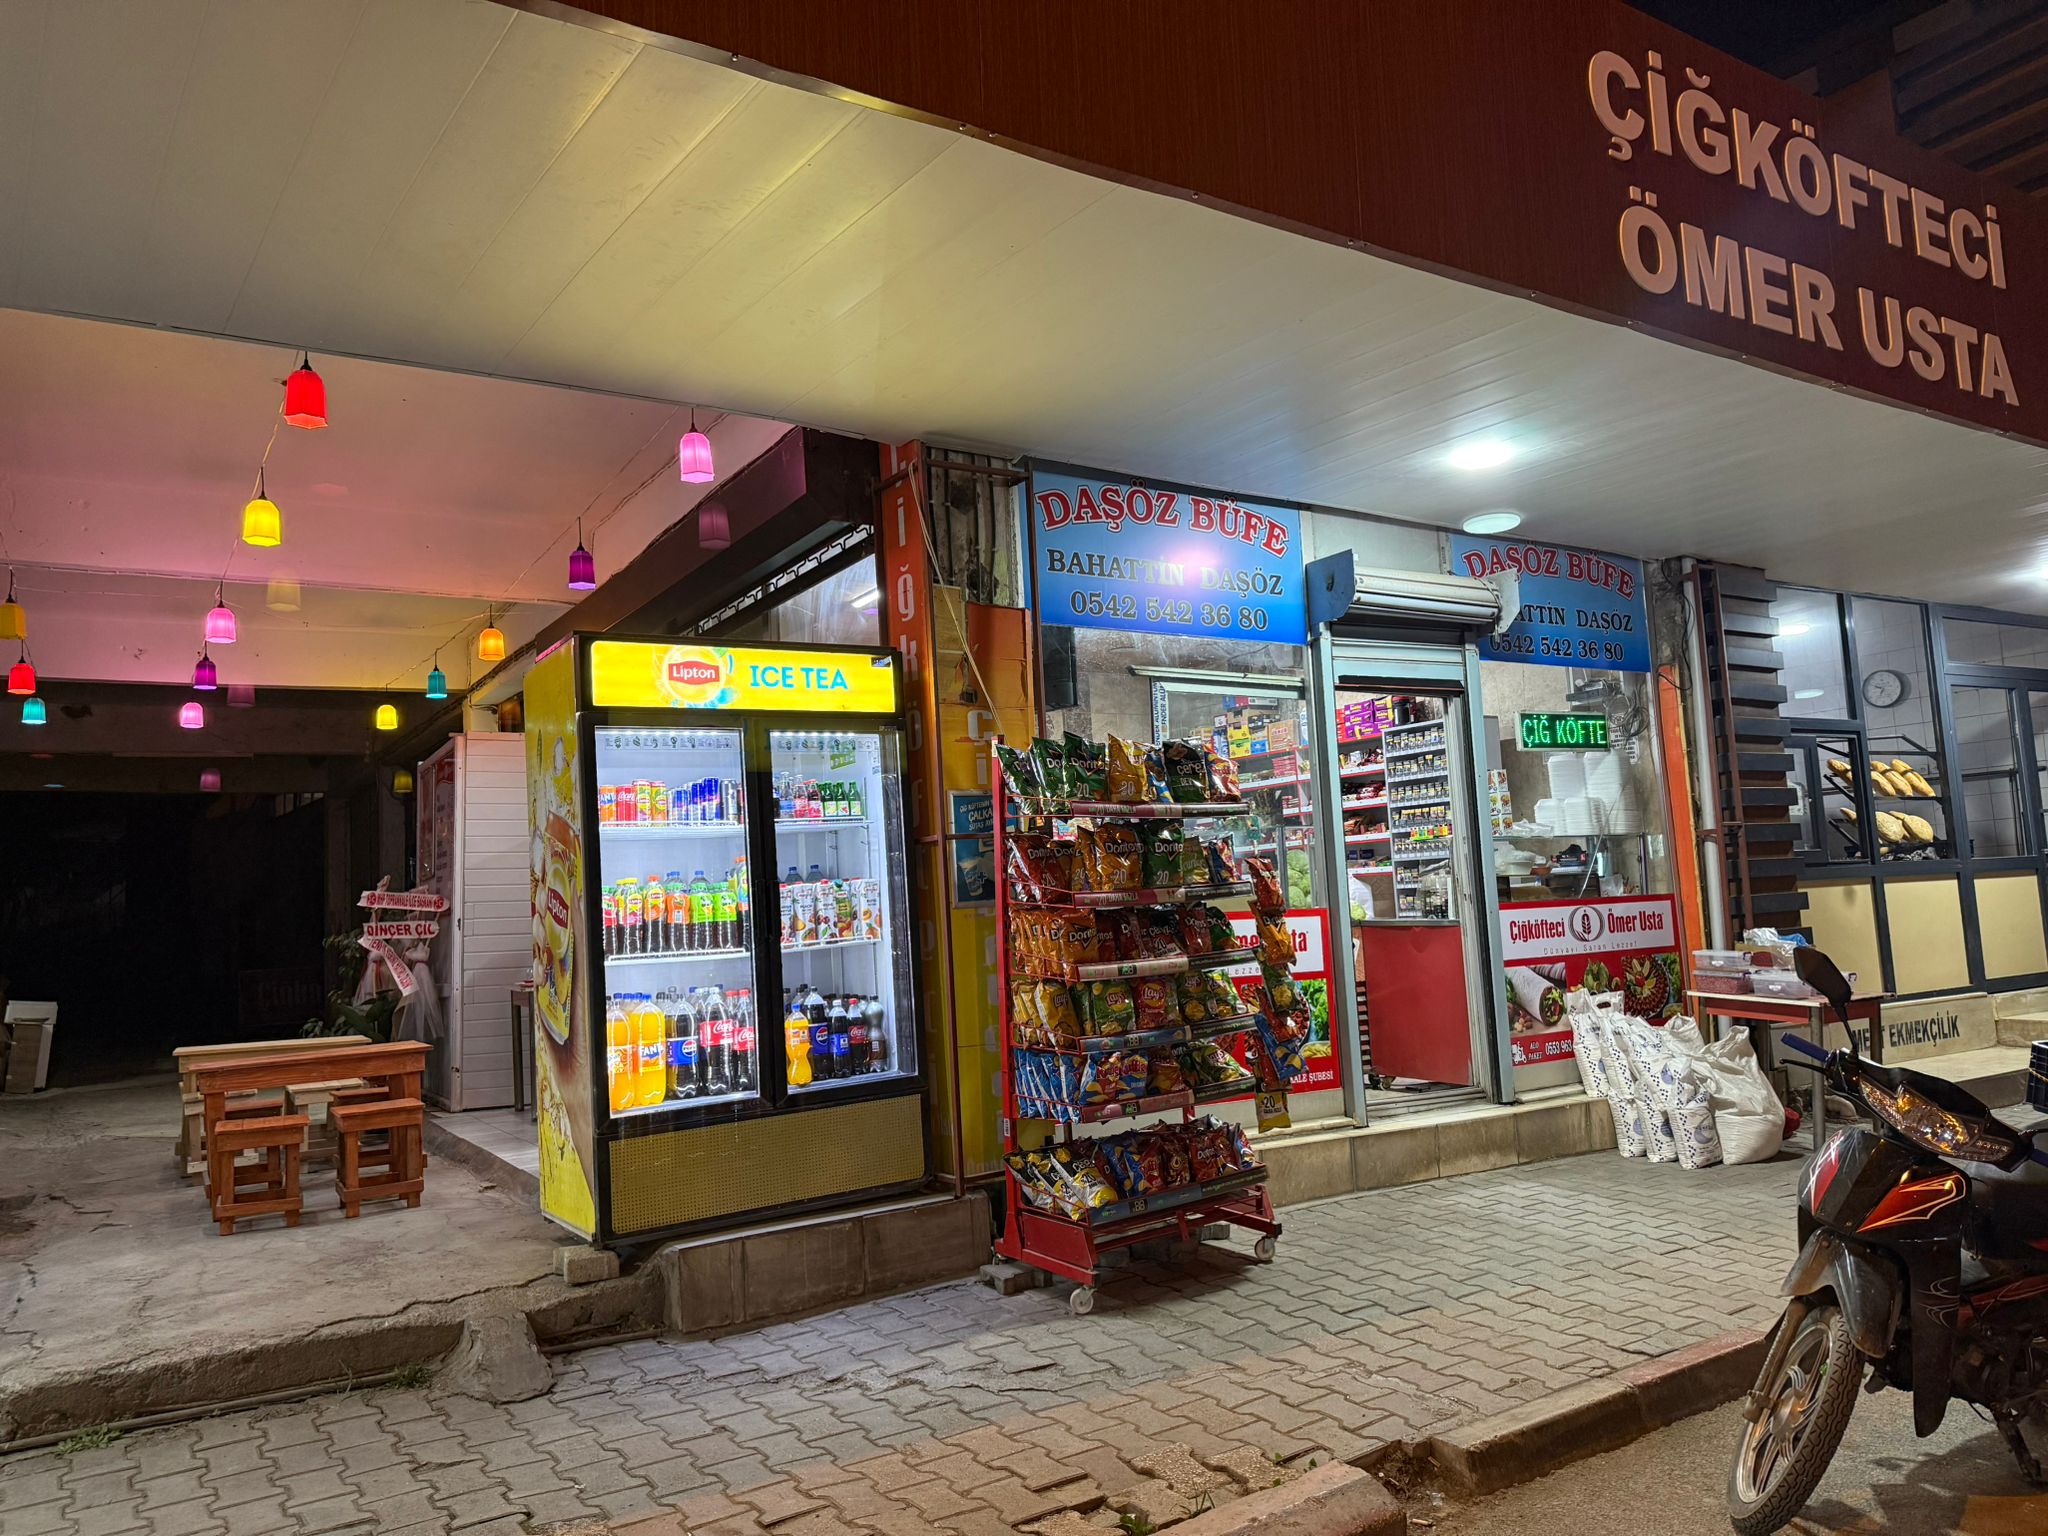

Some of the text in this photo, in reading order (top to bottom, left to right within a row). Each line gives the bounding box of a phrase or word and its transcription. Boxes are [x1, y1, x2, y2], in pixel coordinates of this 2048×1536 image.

[1588, 49, 2007, 290] ÇİĞKÖFTECİ
[1619, 185, 2020, 407] ÖMER USTA
[1034, 479, 1290, 559] DAŞÖZ BÜFE
[1047, 548, 1284, 600] BAHATTİN DAŞÖZ
[1462, 540, 1636, 600] DAŞÖZ BÜFE
[1070, 591, 1269, 630] 0542 542 36 80
[1516, 602, 1633, 634] ATTİN DAŞÖZ
[1490, 634, 1625, 662] 0542 542 36 80
[672, 665, 716, 680] Lipton
[749, 665, 849, 690] ICE TEA
[1522, 714, 1550, 748] ÇİĞ
[1556, 717, 1607, 745] KÖFTE
[547, 889, 567, 923] Lipton
[1509, 909, 1664, 944] Çiğköfteci Ömer Usta
[1143, 985, 1166, 1001] Lay's
[1889, 1012, 1960, 1048] EKMEKÇİLİK
